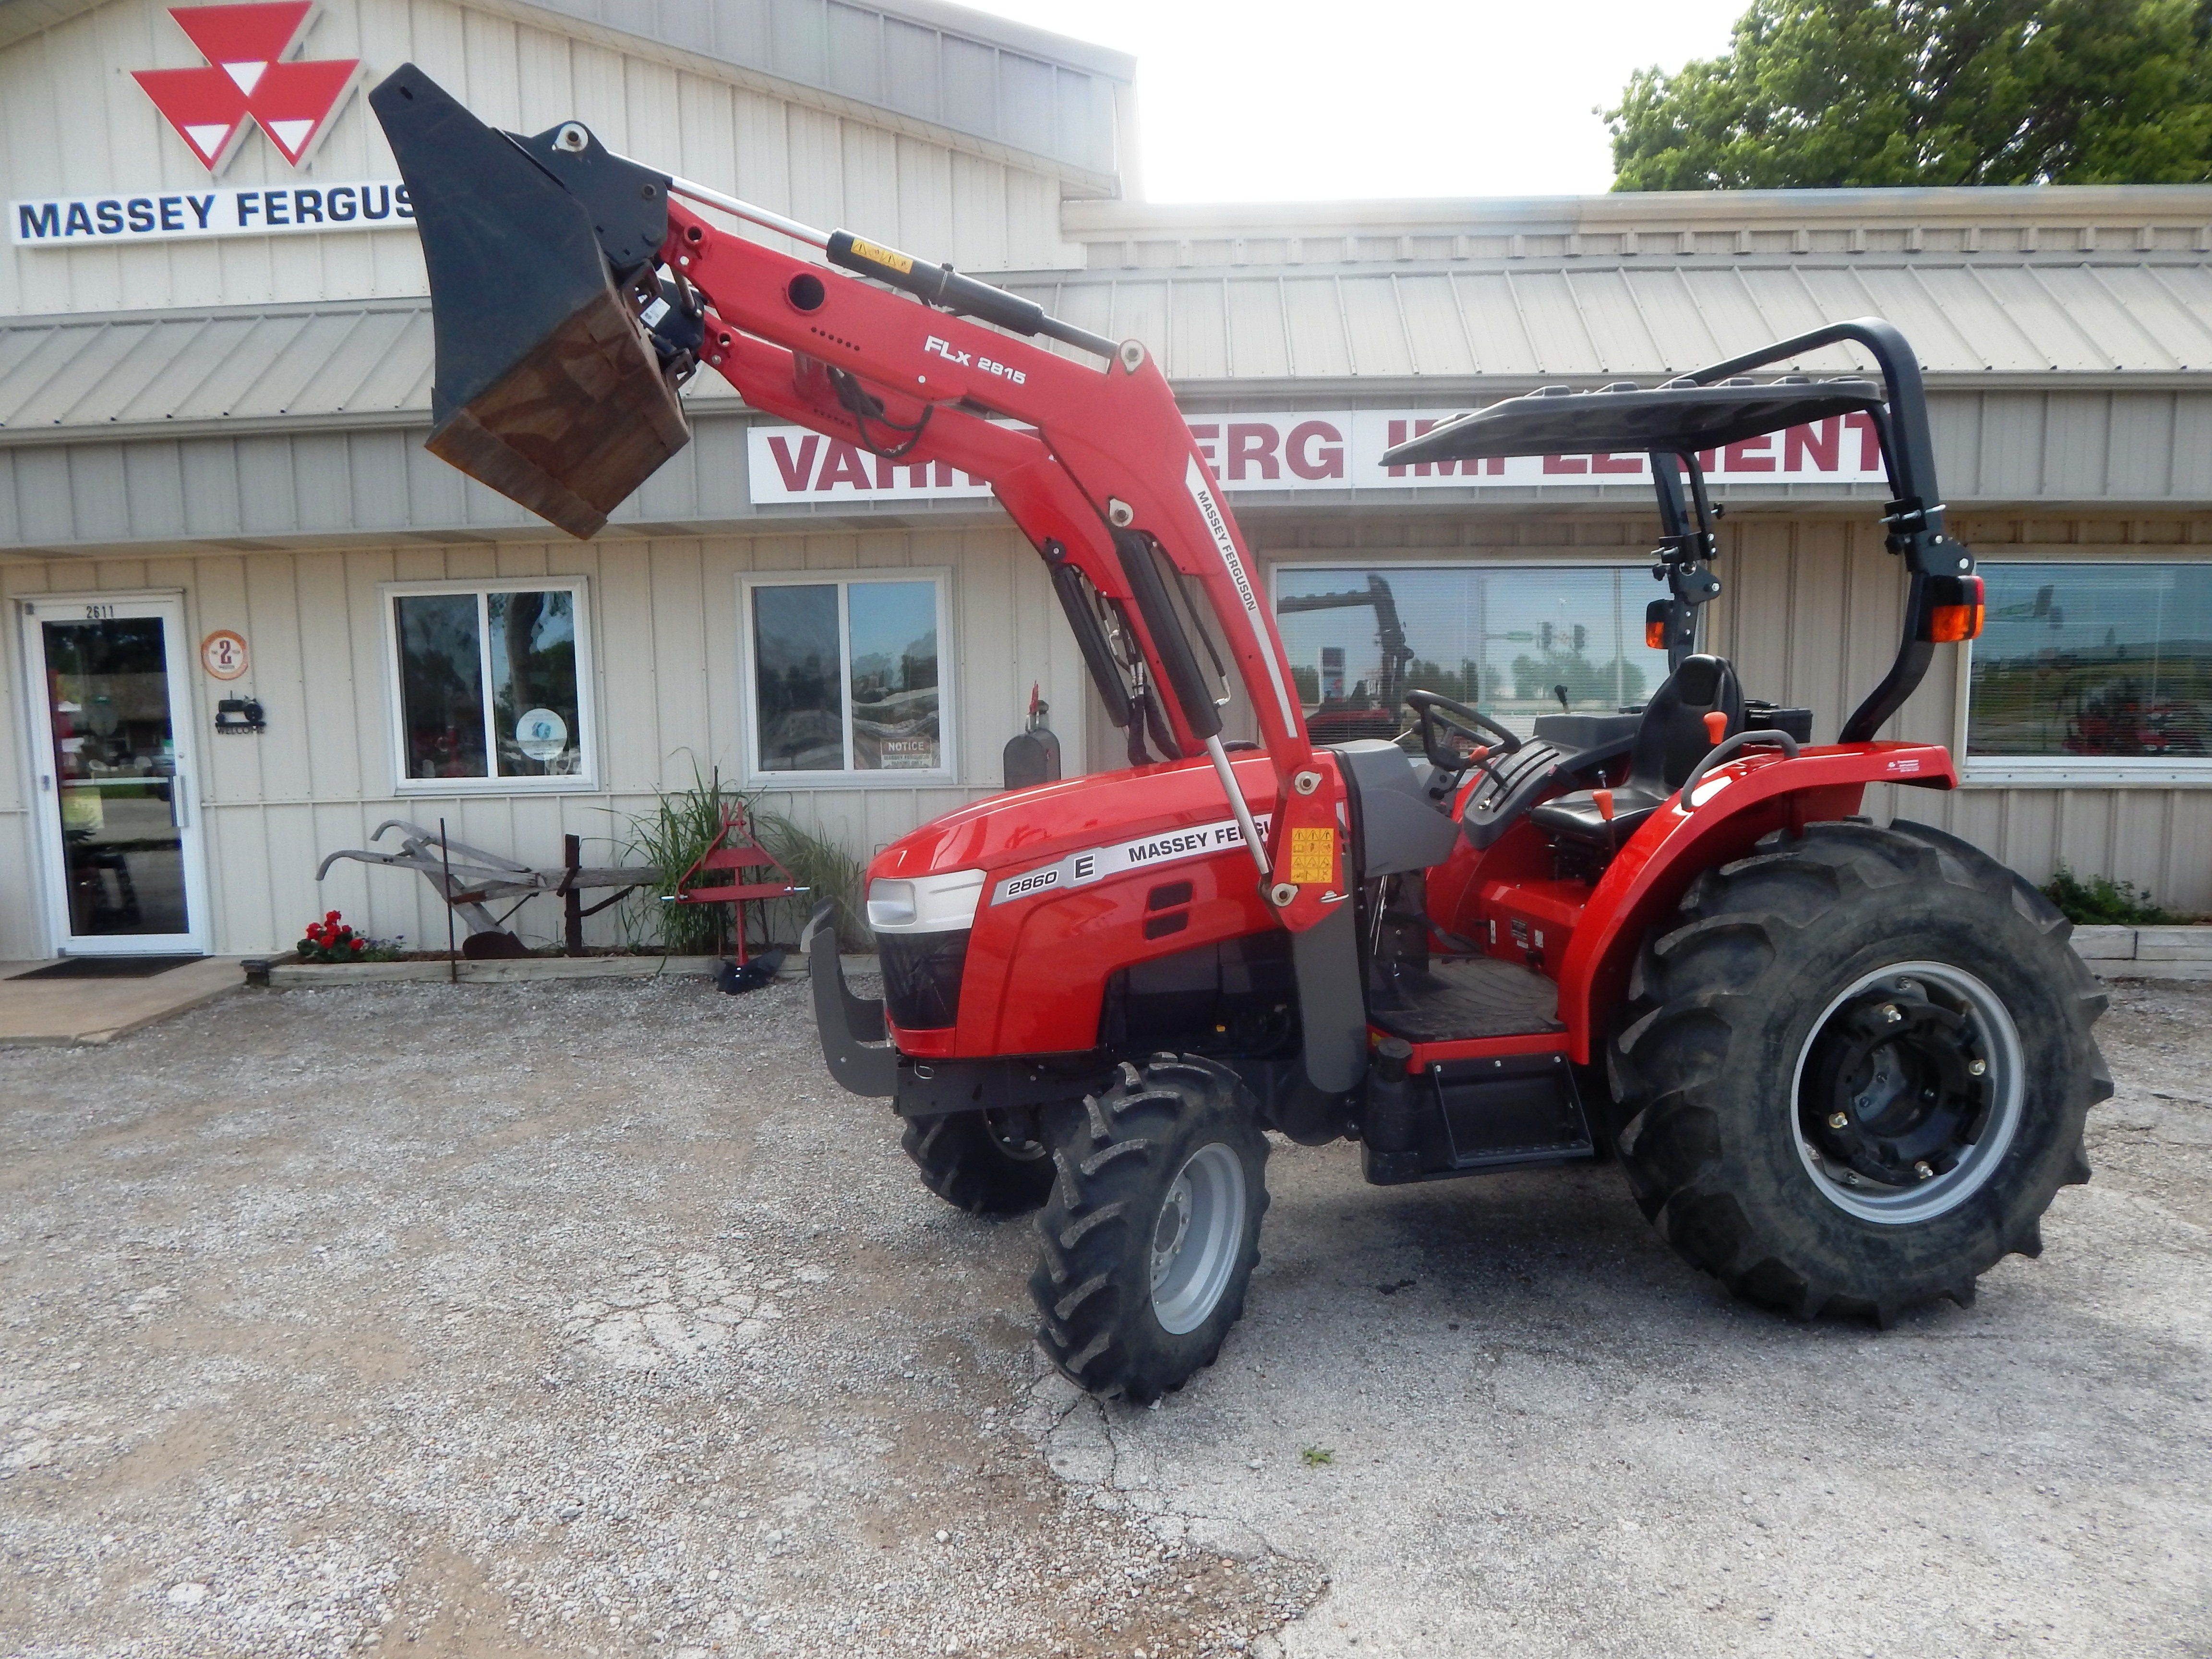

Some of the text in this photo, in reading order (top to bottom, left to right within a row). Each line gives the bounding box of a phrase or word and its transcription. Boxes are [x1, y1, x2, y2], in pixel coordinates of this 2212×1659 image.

[19, 194, 216, 239] MASSEY
[977, 356, 1026, 385] 2815
[1197, 490, 1256, 611] MASSEY FERGUSON
[86, 605, 114, 619] 2611
[219, 640, 232, 664] 2
[888, 741, 925, 752] NOTICE
[1008, 870, 1058, 896] 2860
[1074, 854, 1094, 879] E
[1128, 831, 1208, 862] MASSEY
